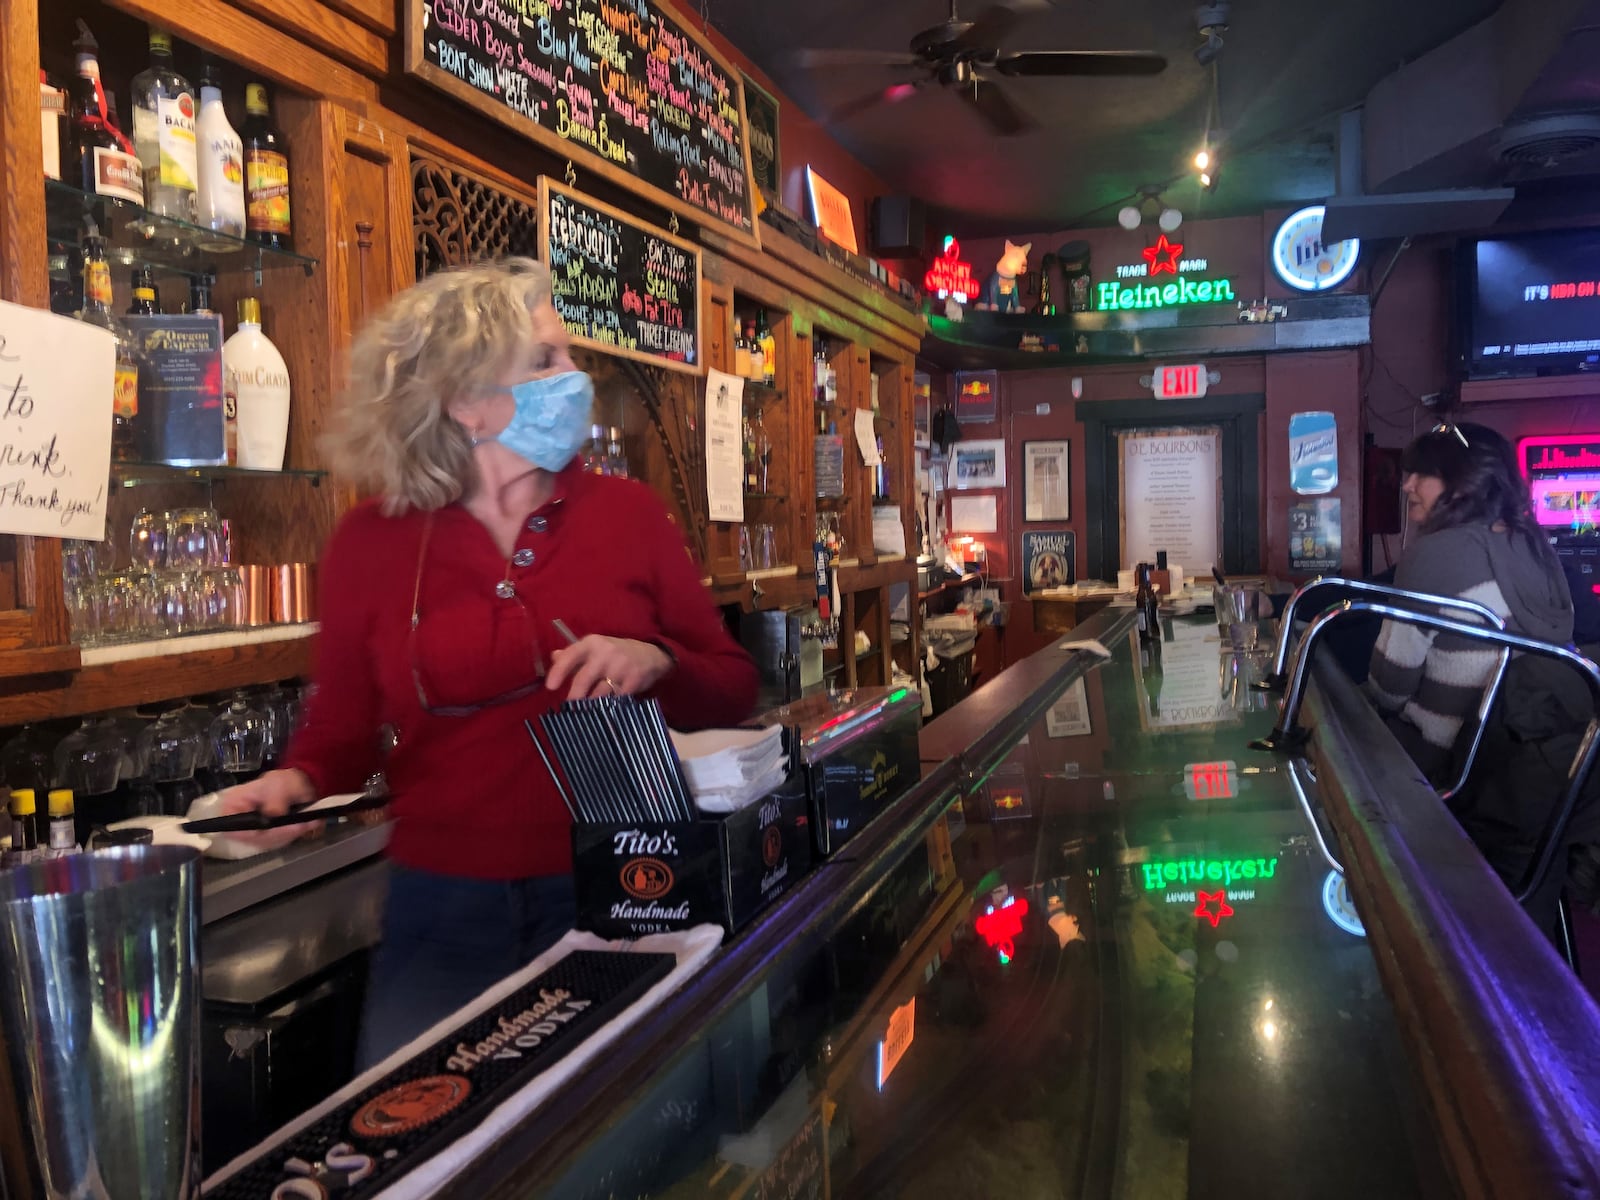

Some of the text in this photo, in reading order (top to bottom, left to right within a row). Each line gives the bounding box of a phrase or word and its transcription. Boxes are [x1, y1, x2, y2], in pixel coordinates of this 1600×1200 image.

[537, 16, 590, 76] Blue Moon
[438, 39, 494, 92] BOAT SHOW
[556, 99, 598, 148] Banana
[551, 198, 613, 271] February
[1116, 258, 1208, 278] TRADE MARK
[646, 270, 679, 304] Stella
[1097, 276, 1235, 310] Heineken
[163, 340, 210, 353] Express
[166, 330, 208, 341] Oregon
[637, 320, 663, 349] THREE
[1, 373, 34, 421] to
[1162, 366, 1199, 397] EXIT
[1150, 439, 1211, 455] BOURBONS
[1029, 533, 1070, 548] SAMUEL
[1032, 543, 1066, 556] ADAMS
[610, 899, 690, 920] Handmade
[630, 923, 672, 934] VODKA
[446, 984, 573, 1075] Handmade
[493, 996, 593, 1064] VODKA
